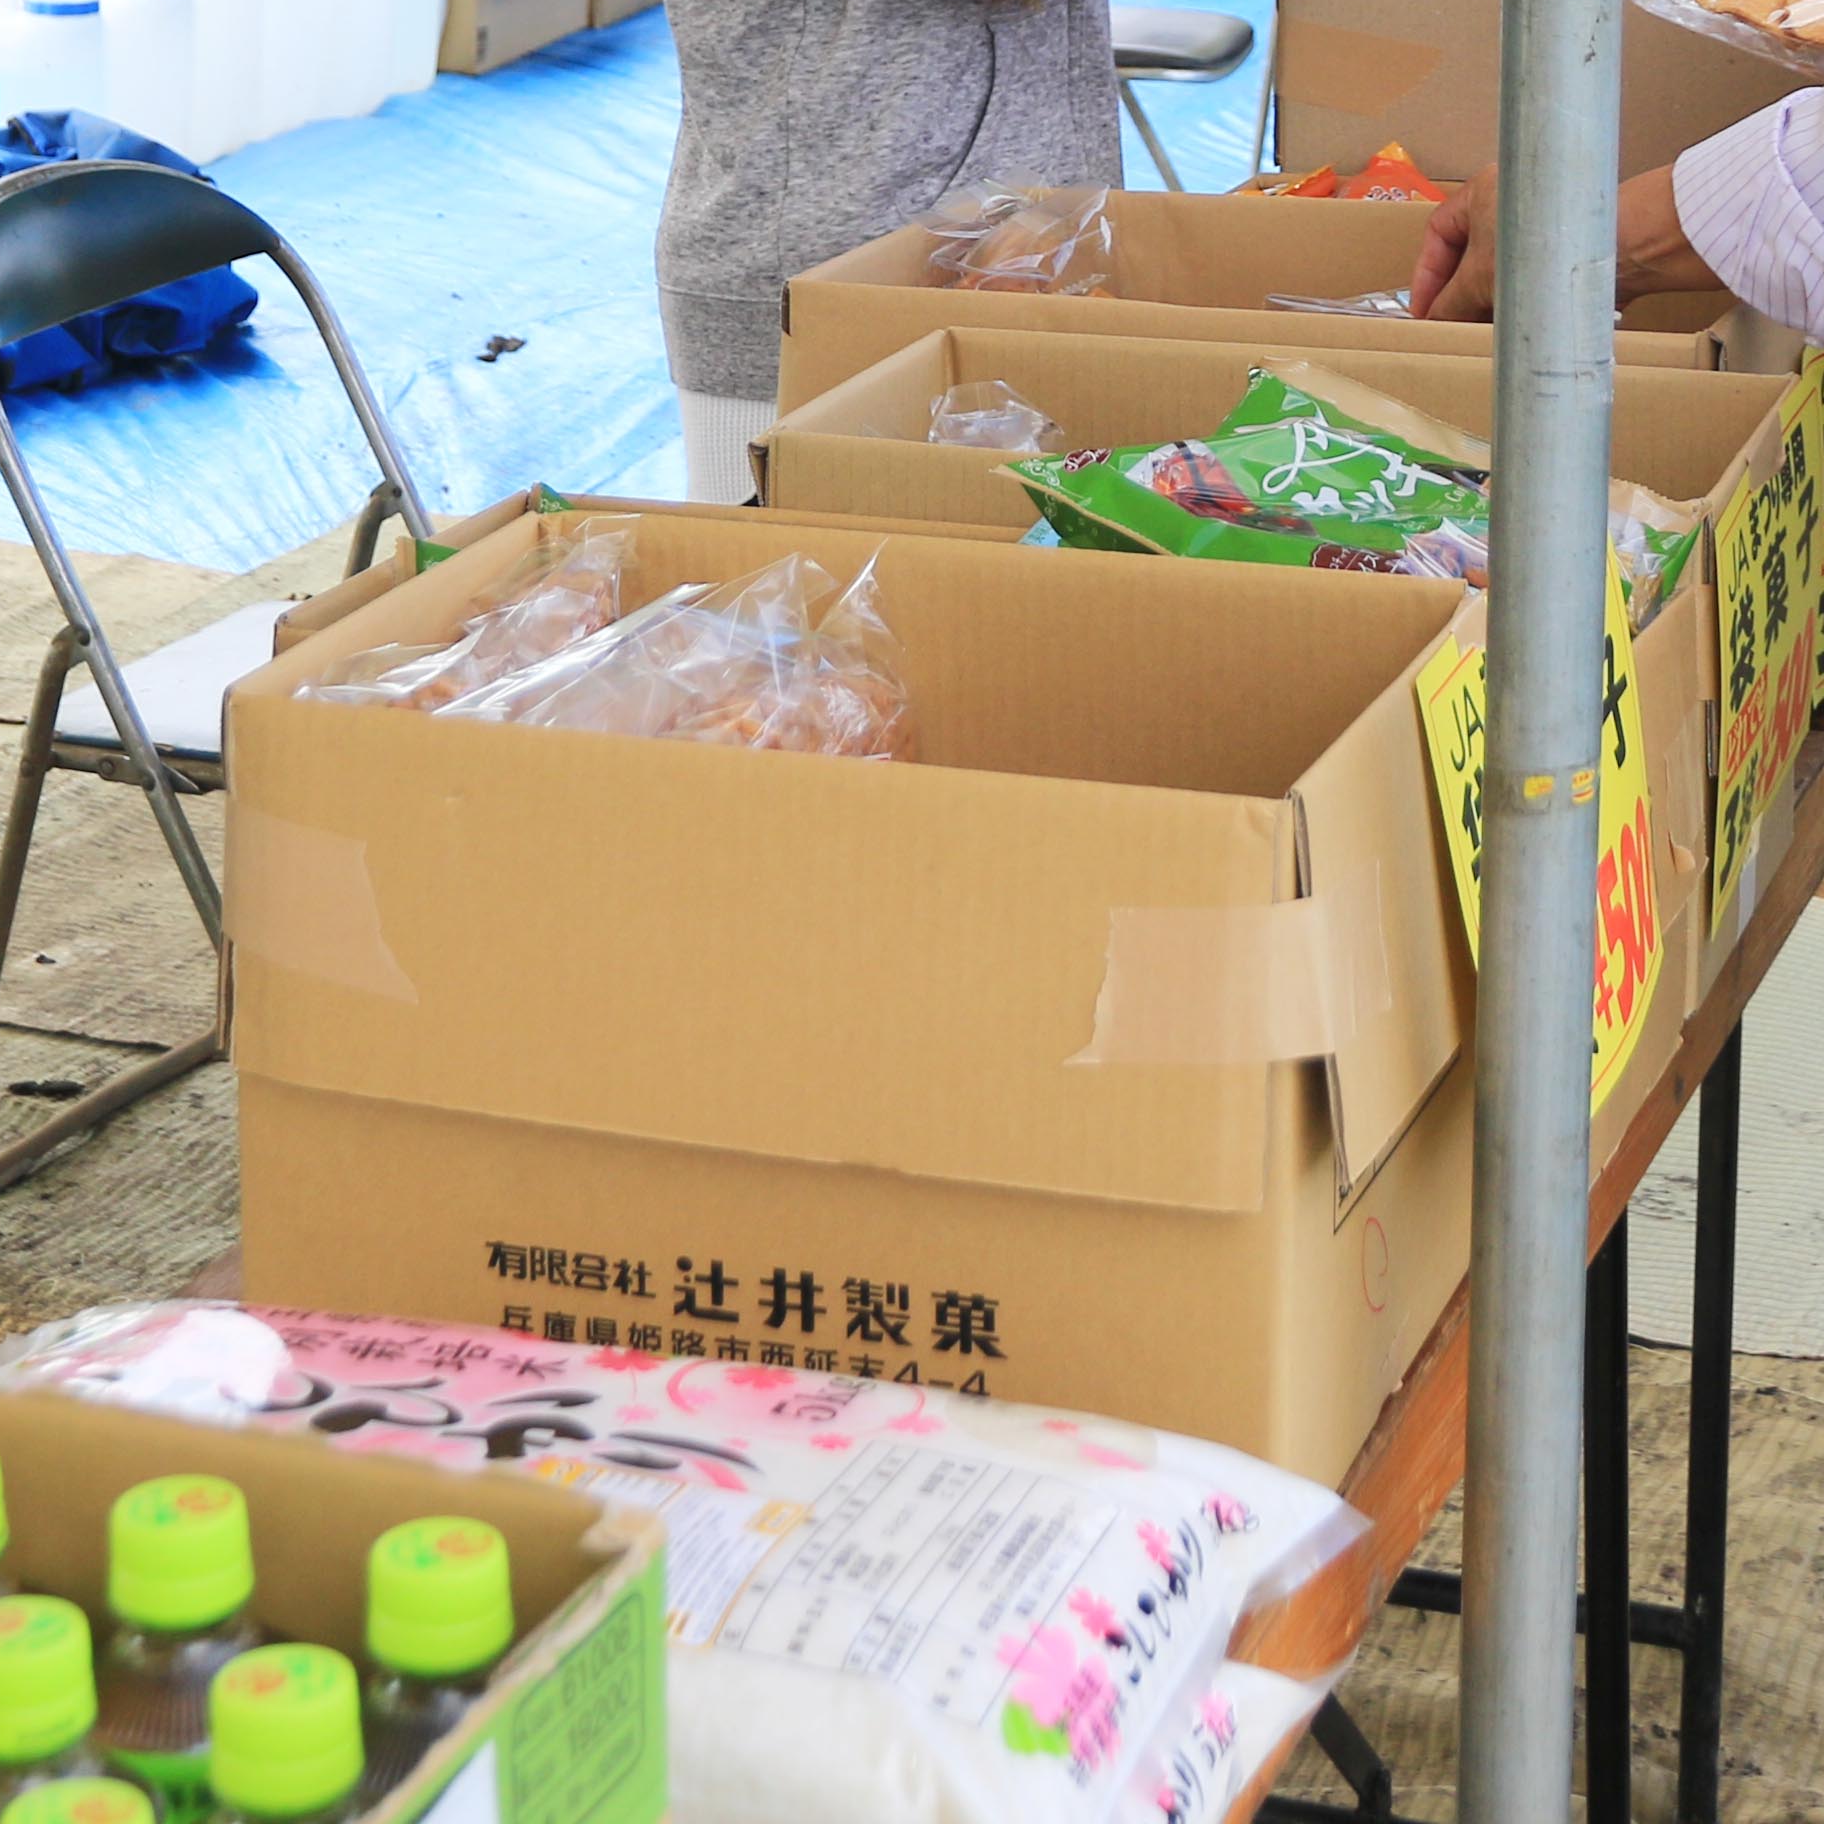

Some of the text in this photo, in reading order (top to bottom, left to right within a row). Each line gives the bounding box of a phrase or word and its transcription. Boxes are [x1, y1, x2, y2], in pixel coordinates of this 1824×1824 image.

[1729, 475, 1819, 712] 袋菓子
[485, 1239, 1008, 1361] 有限会社 辻井製菓
